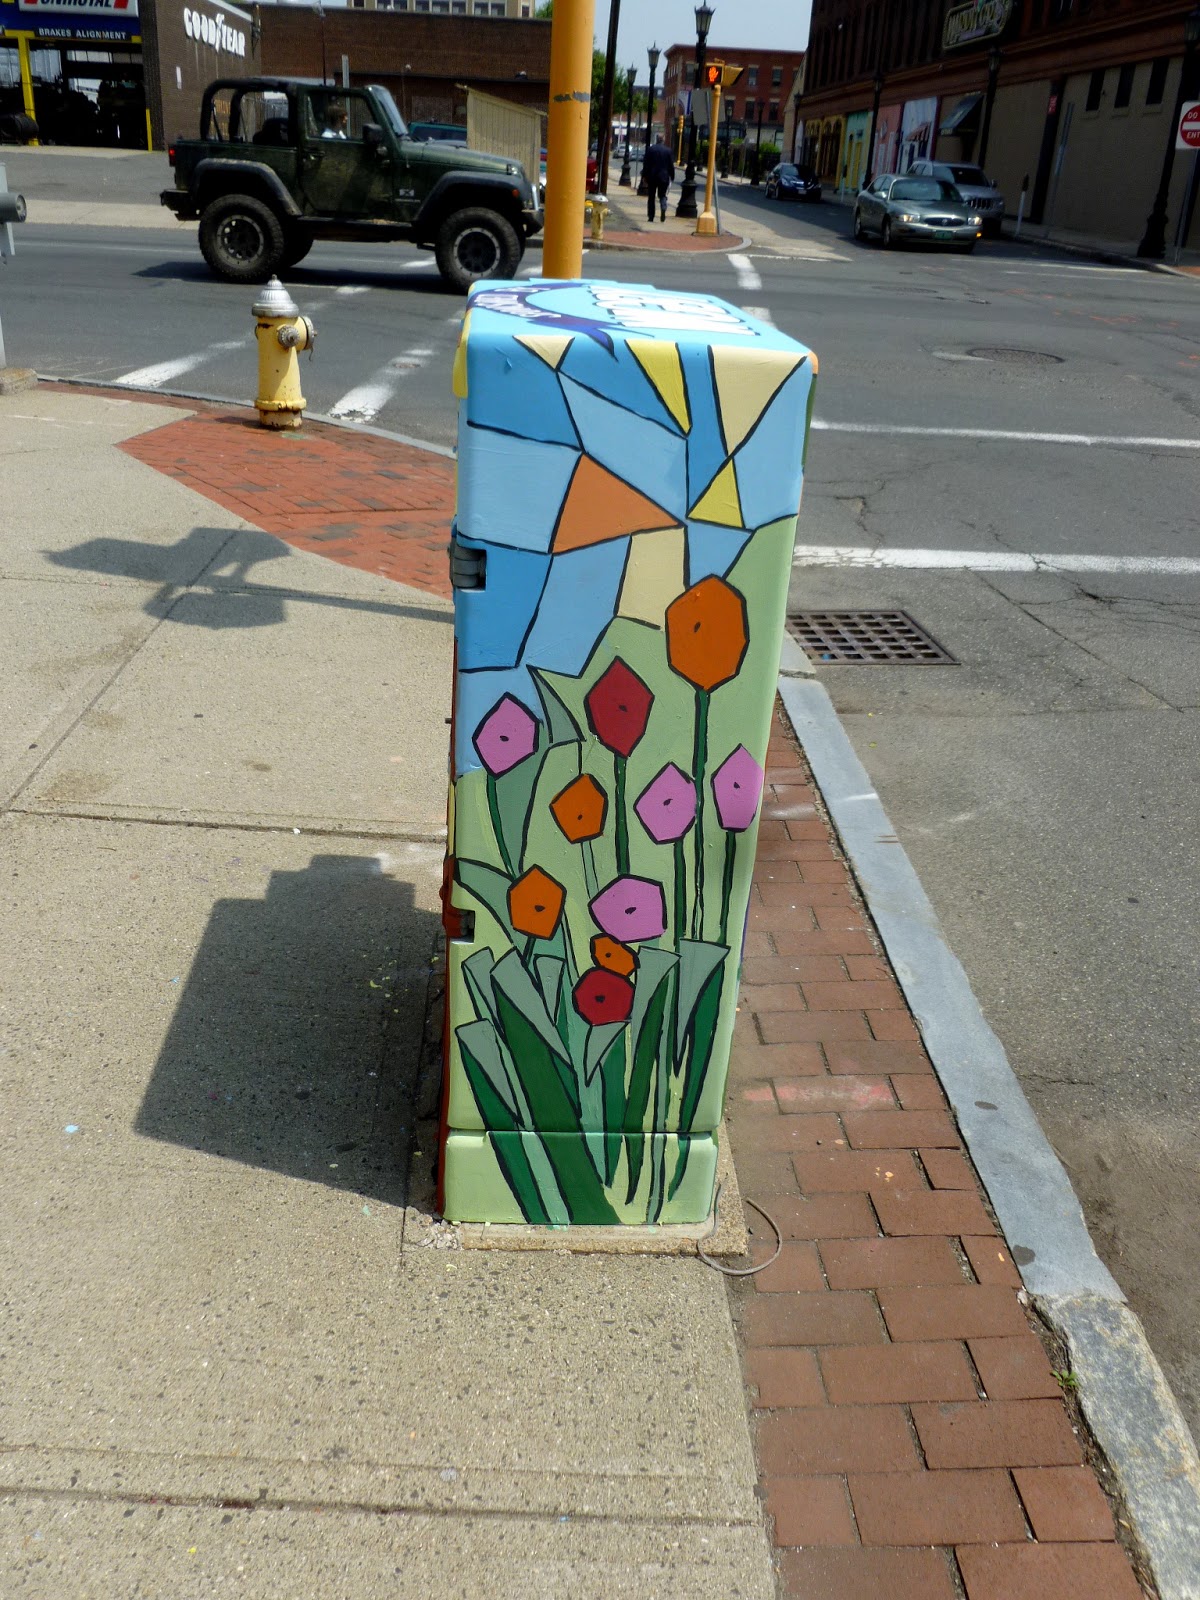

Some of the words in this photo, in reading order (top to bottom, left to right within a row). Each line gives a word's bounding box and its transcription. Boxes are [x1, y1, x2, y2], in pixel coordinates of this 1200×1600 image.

[38, 27, 72, 37] BRAKES
[76, 29, 127, 40] ALIGNMENT
[183, 7, 246, 57] GOODYEAR
[1187, 111, 1198, 119] DO
